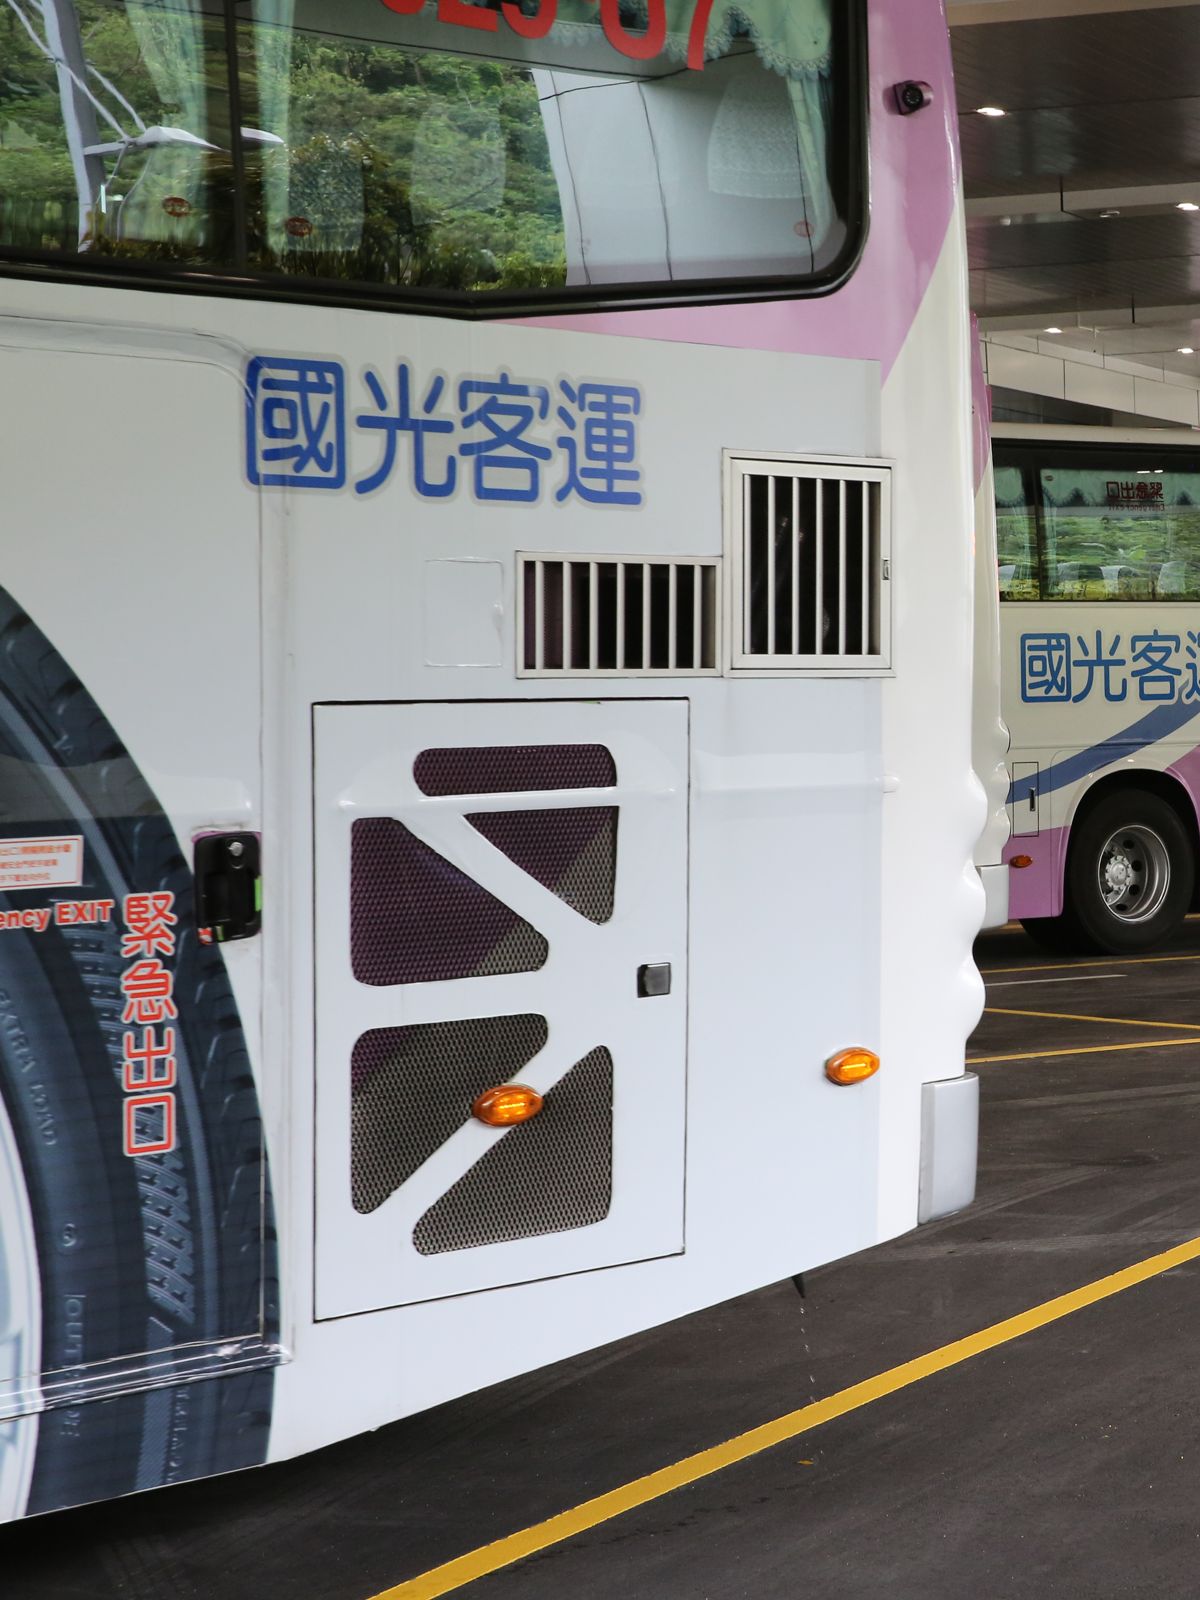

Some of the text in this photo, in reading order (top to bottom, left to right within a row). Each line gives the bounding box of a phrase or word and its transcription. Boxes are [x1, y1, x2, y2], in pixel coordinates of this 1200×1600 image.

[246, 354, 642, 505] 國光客運
[55, 900, 114, 925] EXIT
[123, 892, 176, 1156] 緊急出口
